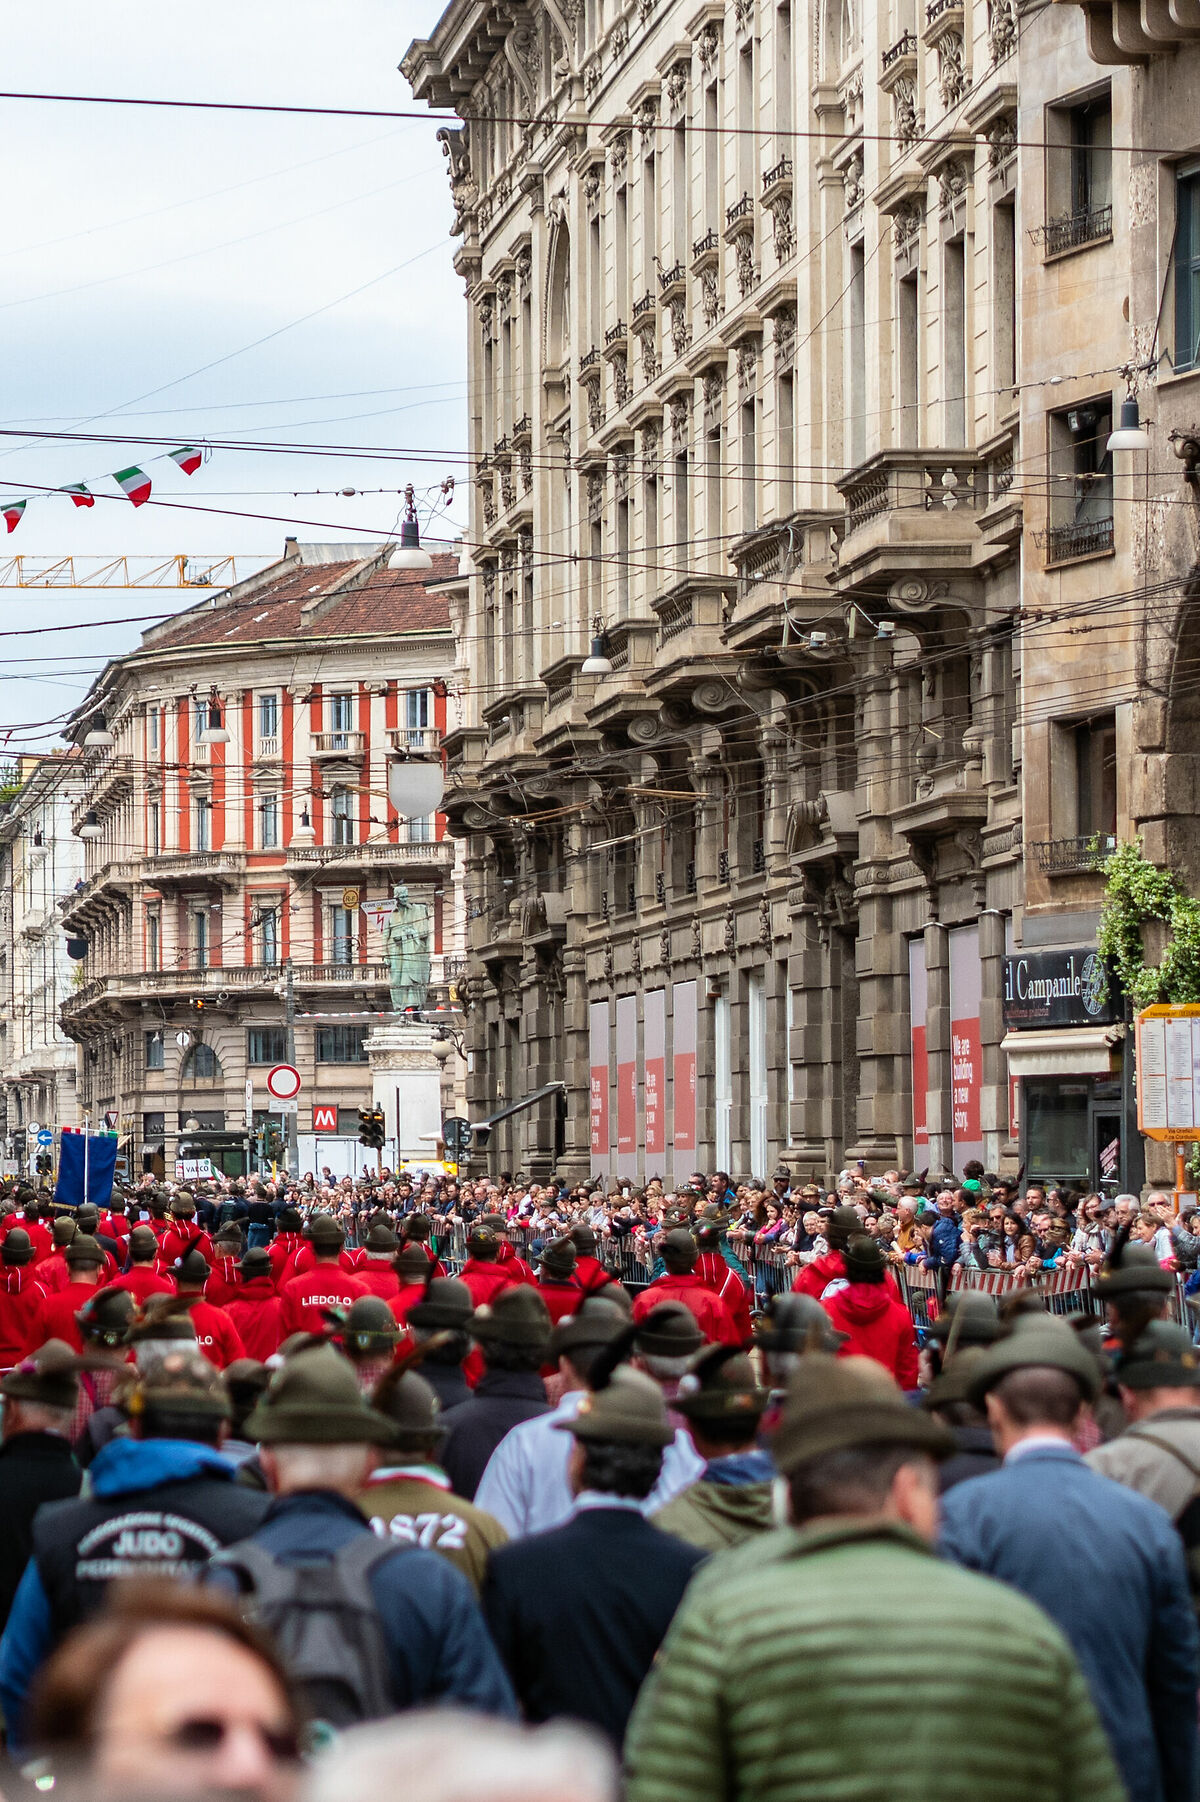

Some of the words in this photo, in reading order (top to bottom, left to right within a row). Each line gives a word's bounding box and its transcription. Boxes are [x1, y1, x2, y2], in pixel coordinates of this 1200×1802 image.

[1005, 961, 1014, 1000] il
[1016, 955, 1081, 1006] Campanile
[953, 1035, 960, 1056] We
[961, 1038, 970, 1056] are
[953, 1058, 973, 1084] building
[958, 1087, 969, 1104] new
[314, 1110, 336, 1126] M
[954, 1107, 969, 1132] story.
[301, 1295, 351, 1307] LIEDOLO
[112, 1530, 183, 1557] JUDO
